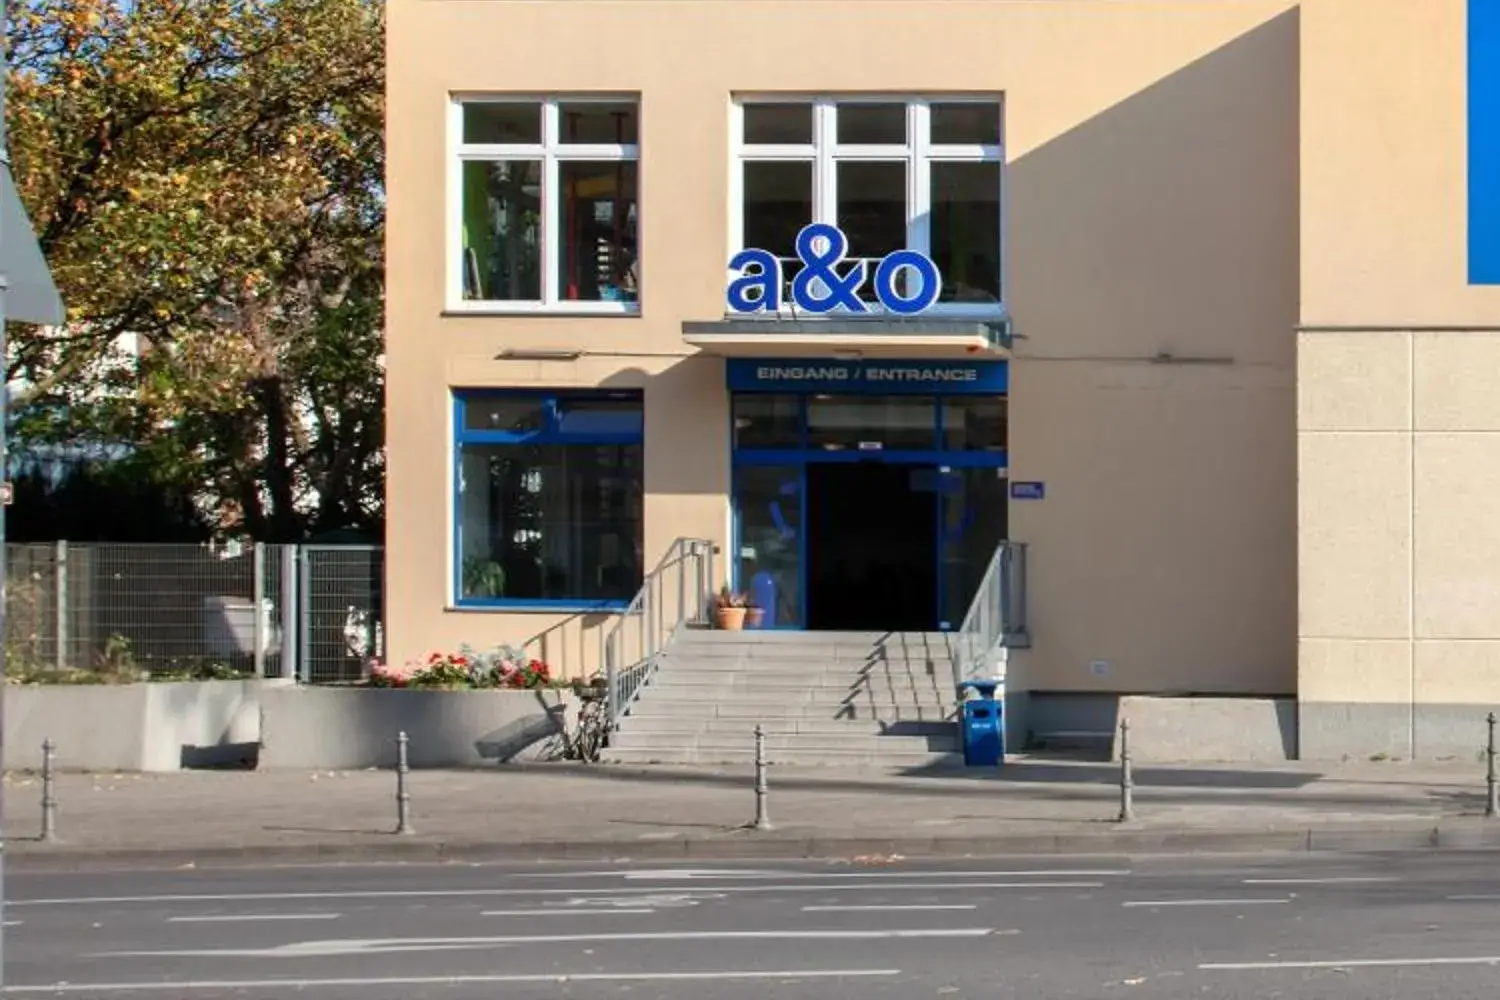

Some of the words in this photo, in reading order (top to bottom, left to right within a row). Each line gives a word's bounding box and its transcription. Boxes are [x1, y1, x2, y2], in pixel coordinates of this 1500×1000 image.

[726, 222, 941, 314] a&o
[757, 367, 848, 380] EINGANG
[866, 368, 977, 381] ENTRANCE
